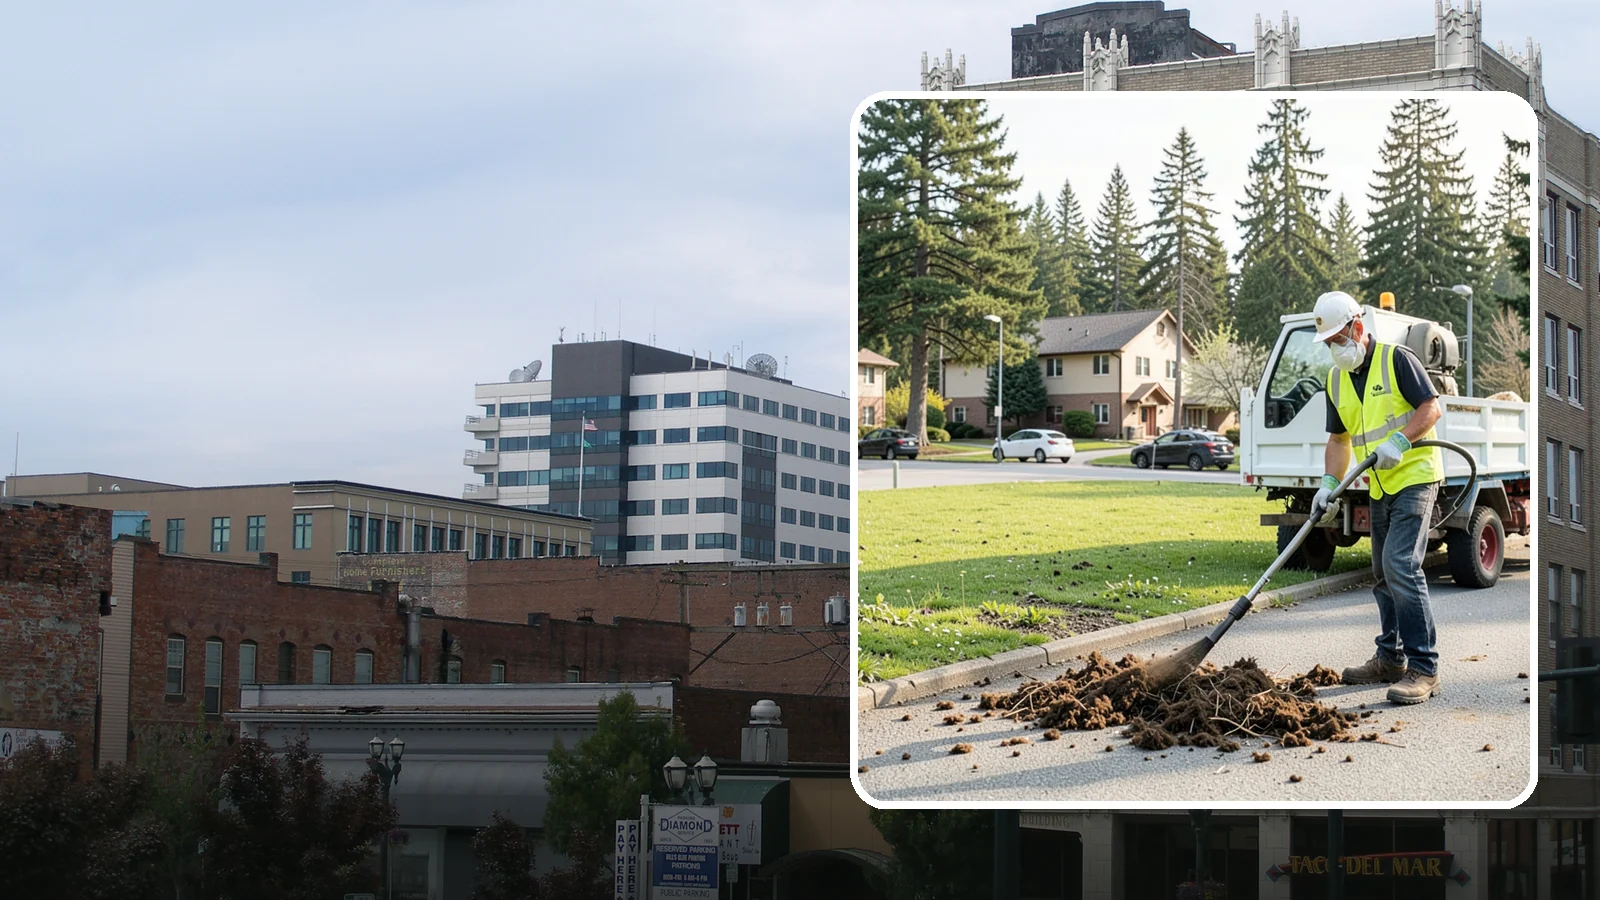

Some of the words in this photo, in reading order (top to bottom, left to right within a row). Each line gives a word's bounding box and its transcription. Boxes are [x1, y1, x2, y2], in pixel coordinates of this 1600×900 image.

[370, 566, 427, 576] Furnishers
[660, 818, 713, 833] DIAMOND
[1022, 815, 1069, 827] BUILDING
[628, 824, 636, 852] PAY
[689, 846, 716, 854] PARKING
[722, 852, 738, 862] Soup
[672, 862, 701, 870] PATRONS
[1290, 856, 1329, 874] TAC
[1346, 857, 1385, 875] DEL
[1392, 858, 1442, 876] MAR
[628, 856, 636, 894] HERE
[660, 888, 682, 897] PUBLIC
[684, 889, 710, 898] PARKING
